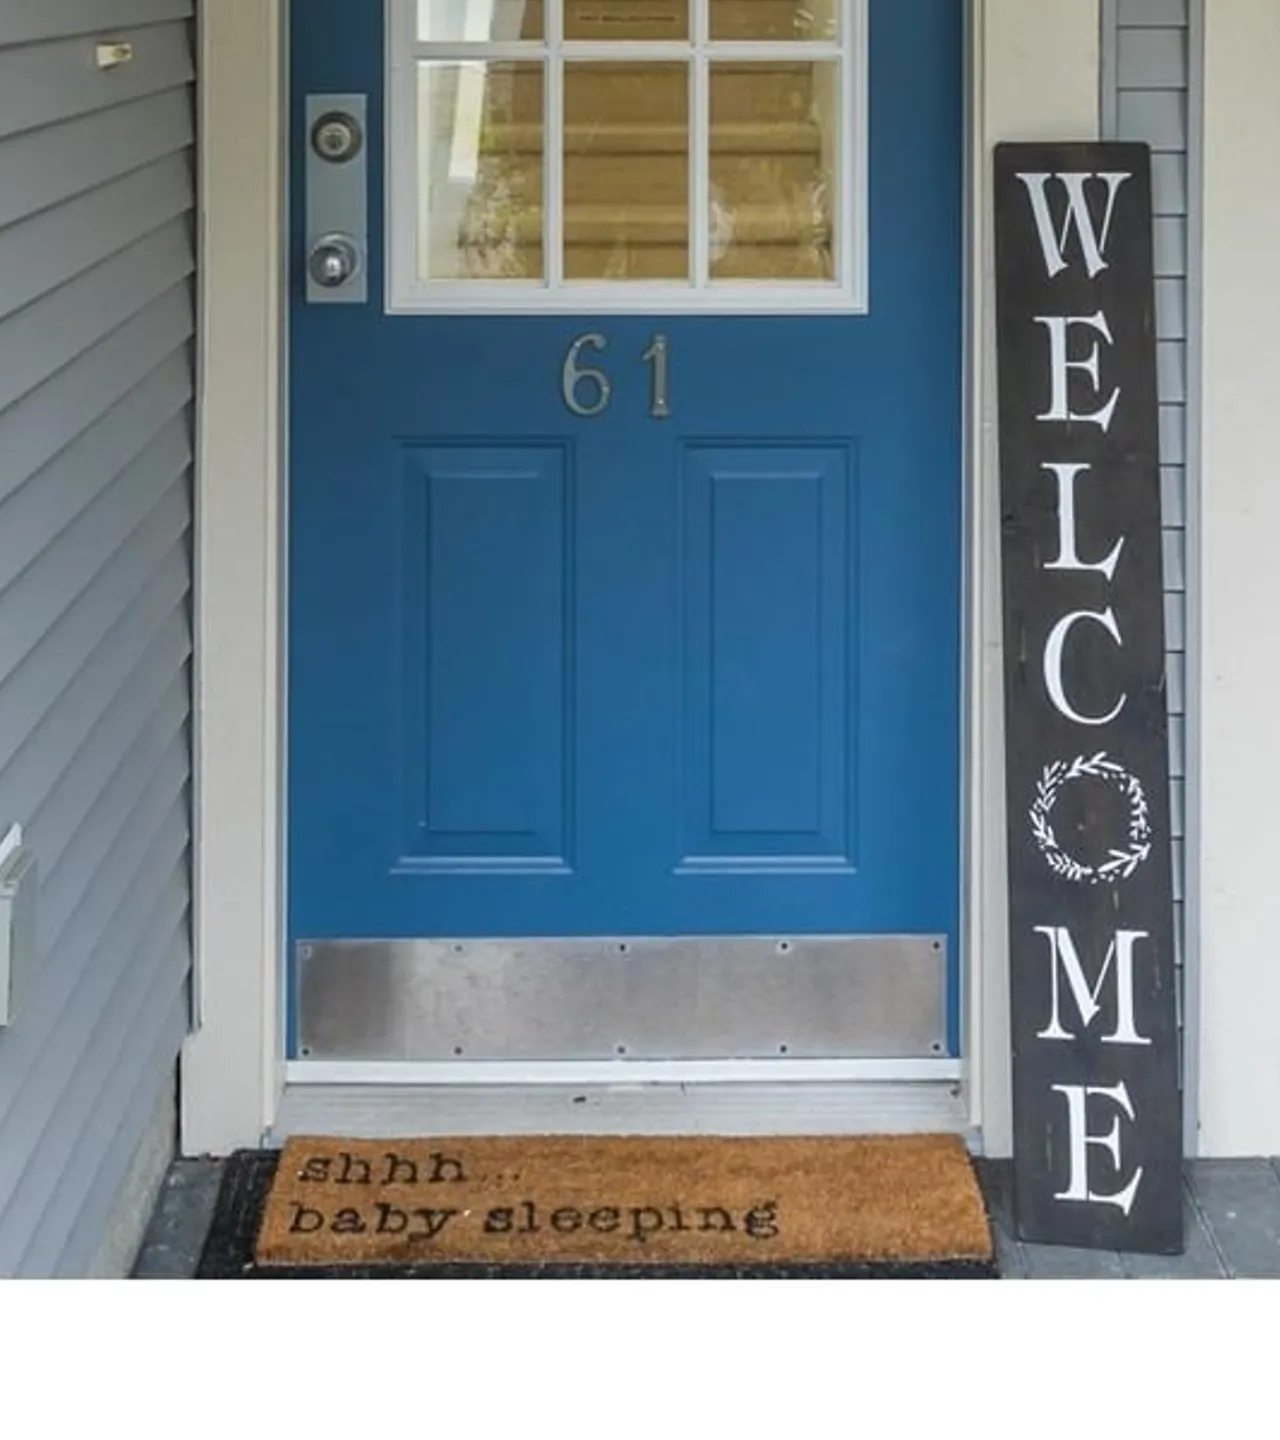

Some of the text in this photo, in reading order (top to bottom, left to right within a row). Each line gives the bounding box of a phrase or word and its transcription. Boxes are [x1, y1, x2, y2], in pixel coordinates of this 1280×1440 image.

[562, 332, 669, 417] 61
[1014, 171, 1153, 1217] WELCOME
[289, 1200, 781, 1243] baby sleeping
